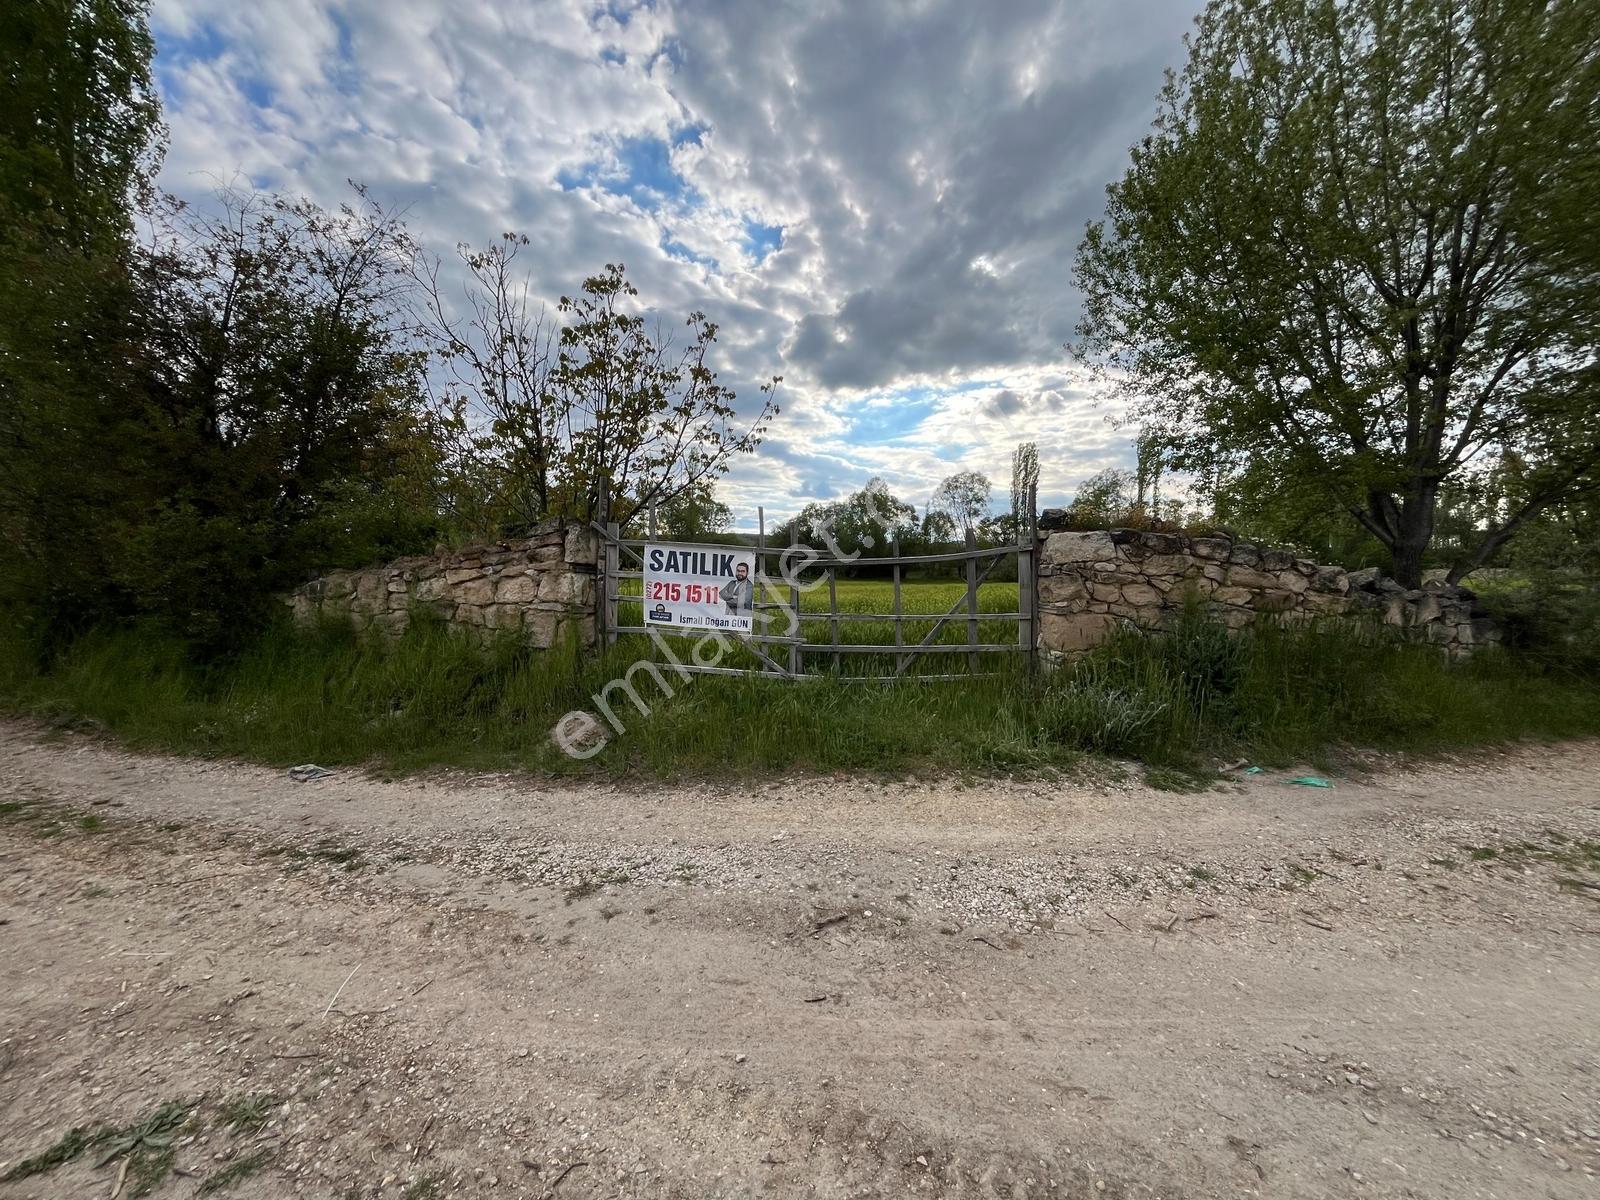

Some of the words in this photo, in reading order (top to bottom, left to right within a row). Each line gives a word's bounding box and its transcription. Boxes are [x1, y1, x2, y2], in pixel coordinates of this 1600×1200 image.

[649, 549, 735, 577] SATILIK
[653, 582, 681, 602] 215
[685, 584, 702, 603] 15
[704, 585, 719, 605] 11
